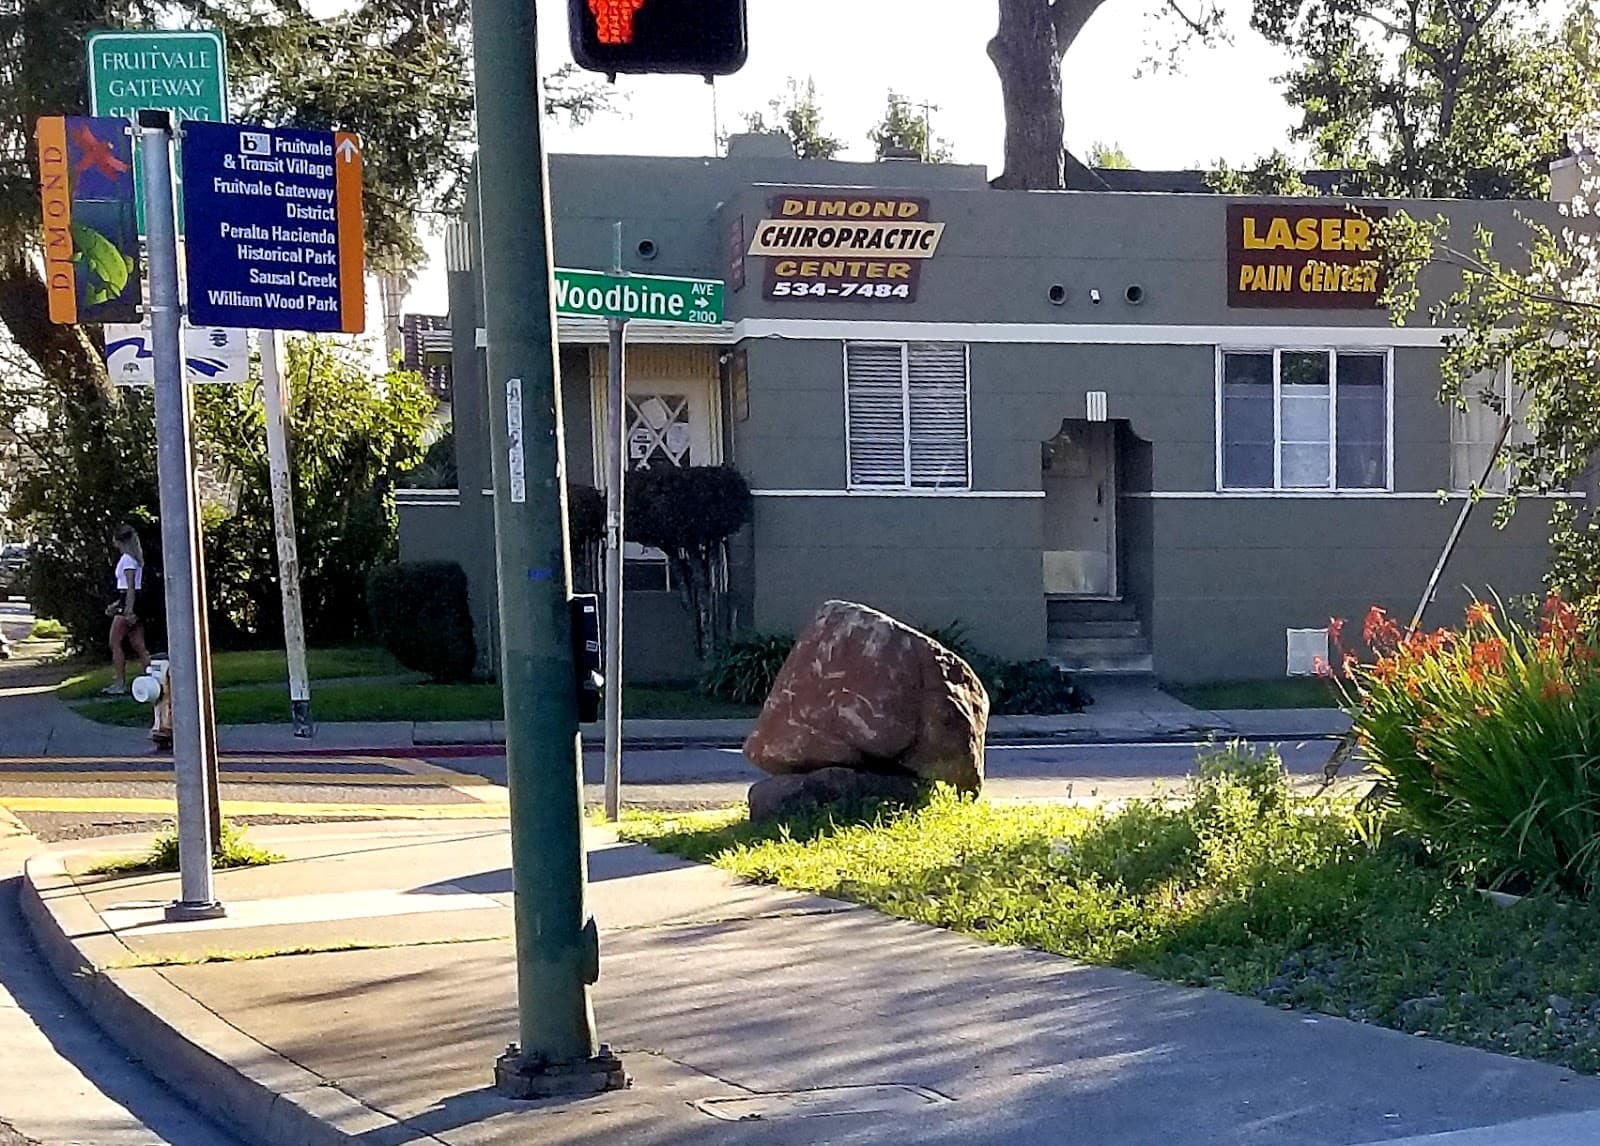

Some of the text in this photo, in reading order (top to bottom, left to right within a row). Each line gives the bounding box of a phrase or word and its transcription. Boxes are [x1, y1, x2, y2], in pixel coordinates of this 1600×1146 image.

[102, 51, 211, 70] FRUITVALE
[109, 79, 205, 97] GATEWAY
[275, 137, 332, 156] Fruitvale
[224, 154, 334, 179] & Transit Village
[214, 177, 334, 204] Fruitvale Gateway
[44, 146, 70, 290] DIMOND
[287, 202, 336, 221] District
[781, 199, 920, 218] DIMOND
[220, 222, 336, 244] Peralta Hacienda
[760, 226, 936, 250] CHIROPRACTIC
[1243, 217, 1371, 250] LASER
[238, 244, 337, 265] Historical Park
[250, 268, 337, 288] Sausal Creek
[774, 261, 912, 278] CENTER
[1239, 264, 1293, 292] PAIN
[691, 283, 715, 296] AVE
[772, 282, 910, 298] 534-7484
[207, 290, 338, 312] William Wood Park
[688, 311, 717, 324] 2100
